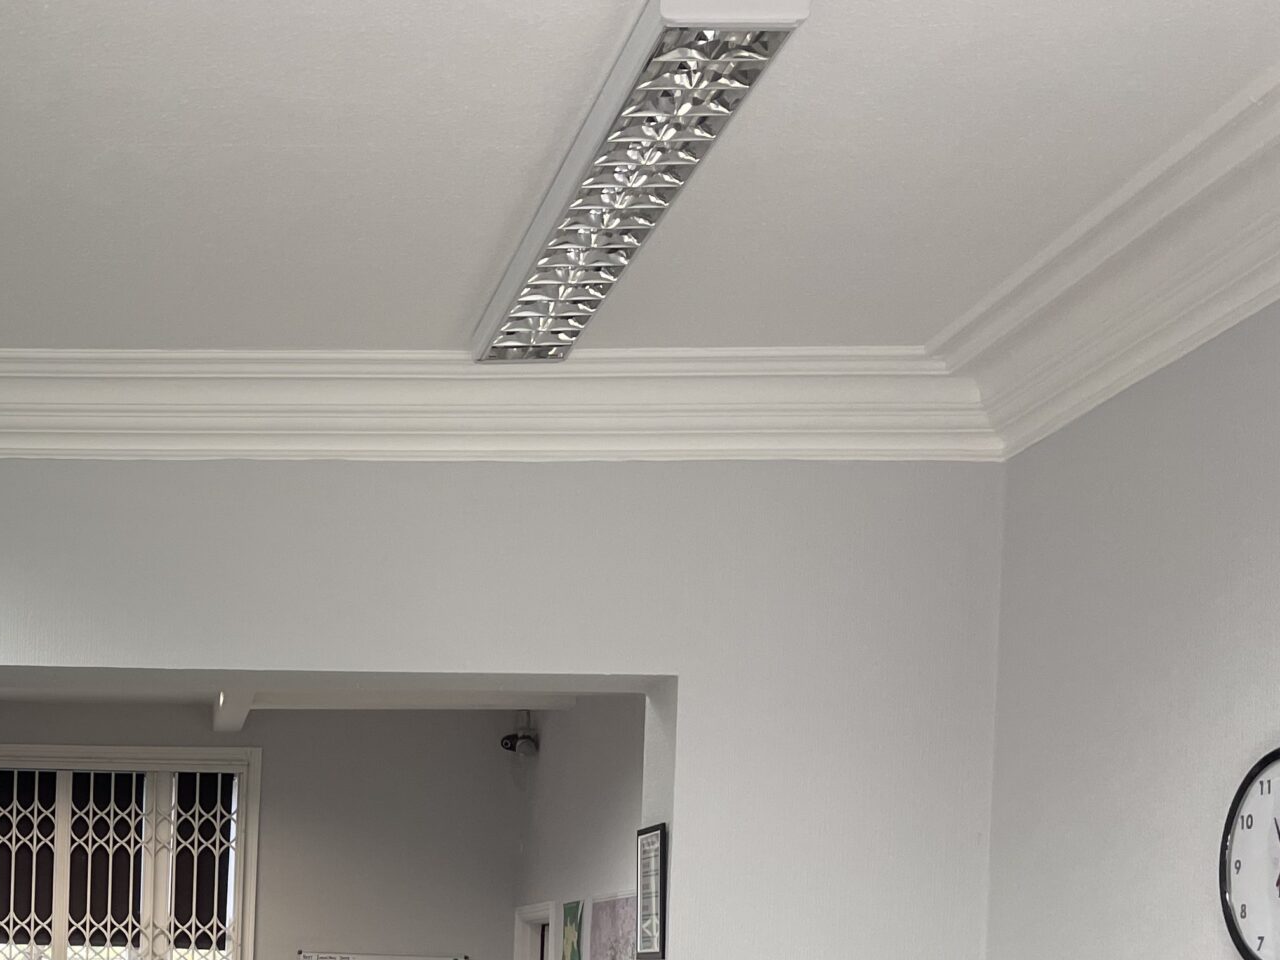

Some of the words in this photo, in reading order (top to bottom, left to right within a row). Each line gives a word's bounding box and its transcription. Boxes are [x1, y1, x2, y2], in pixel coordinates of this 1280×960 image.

[1259, 779, 1272, 796] 11
[1240, 814, 1253, 830] 10
[1234, 859, 1242, 875] 9
[1239, 904, 1247, 919] 8
[1256, 936, 1265, 951] 7
